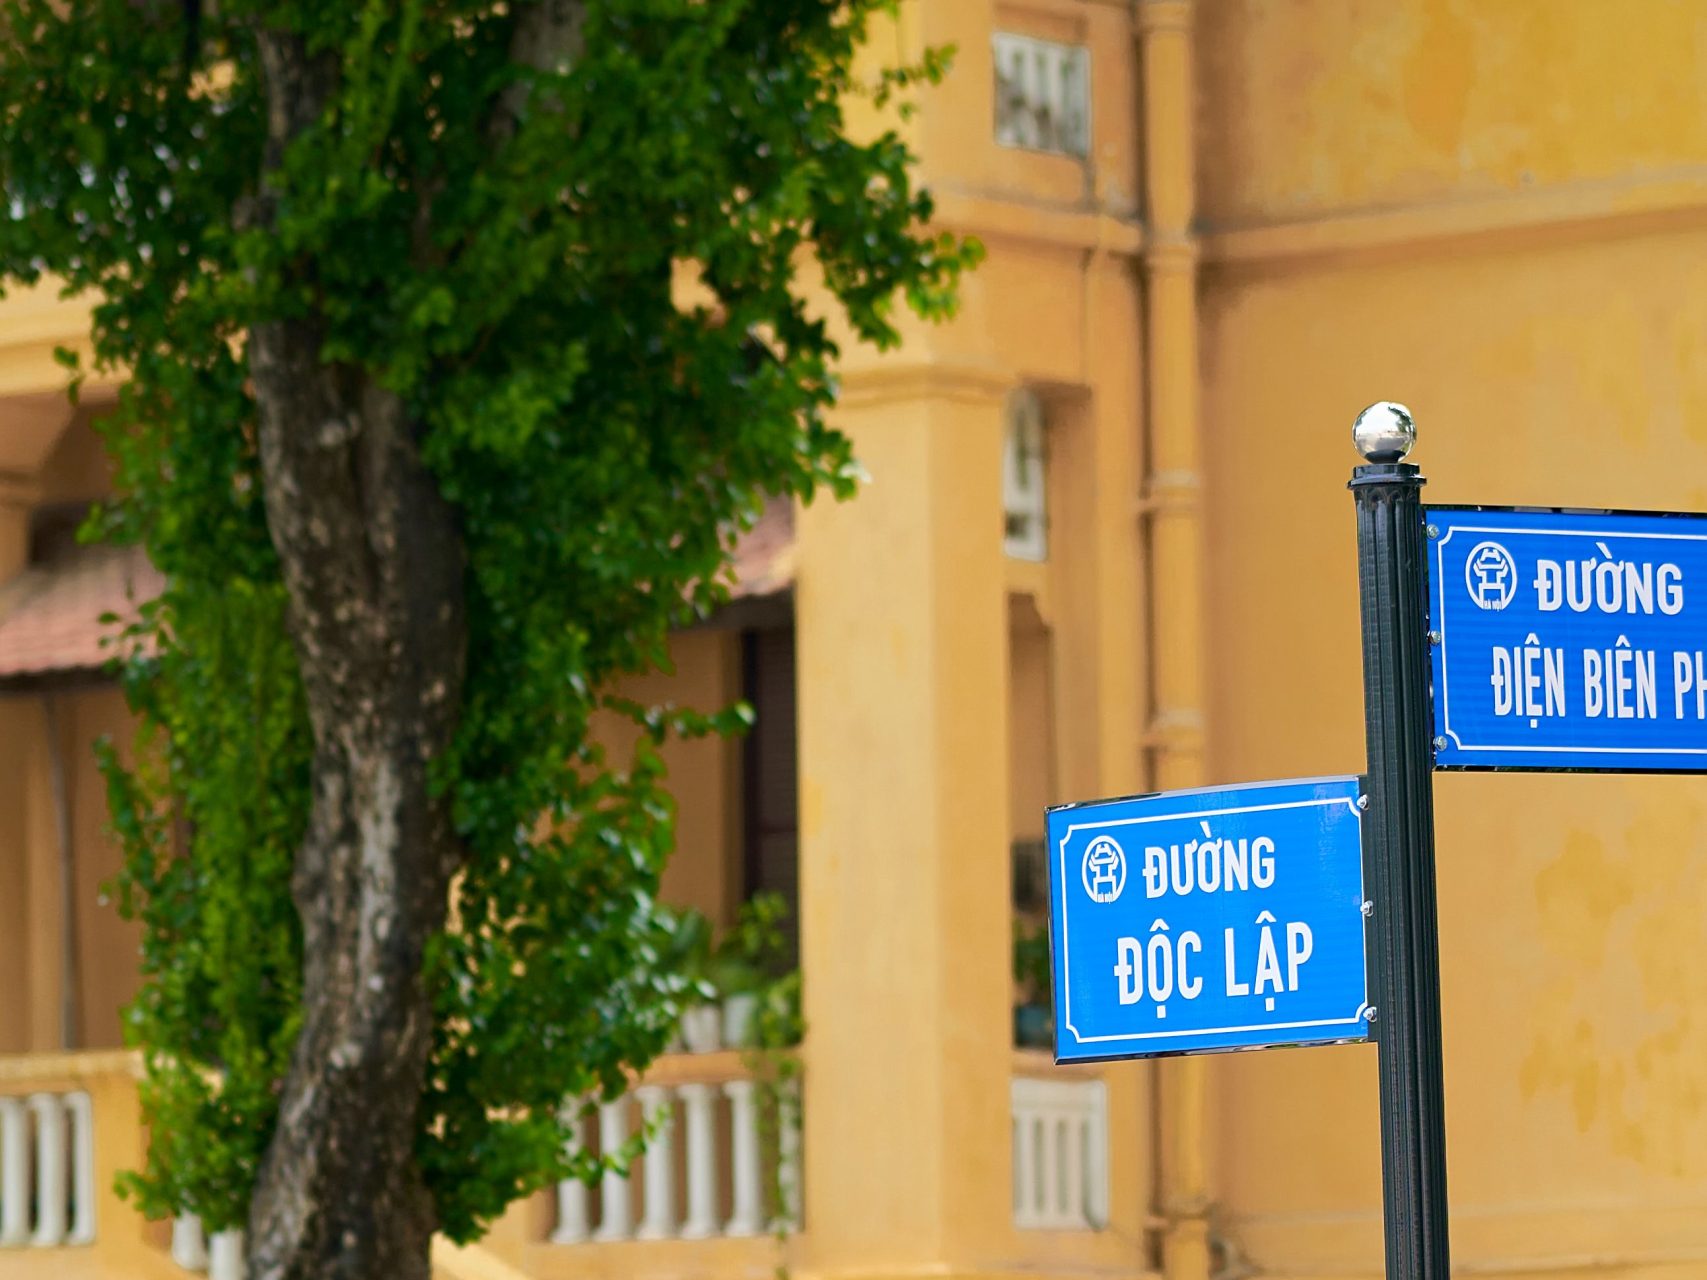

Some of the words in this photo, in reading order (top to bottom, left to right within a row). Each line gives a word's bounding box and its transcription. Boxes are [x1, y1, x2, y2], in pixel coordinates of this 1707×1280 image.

[1533, 541, 1684, 615] ĐƯỜNG
[1491, 632, 1566, 728] ĐIỆN
[1583, 634, 1657, 719] BIÊN
[1142, 821, 1275, 899] ĐƯỜNG
[1114, 918, 1203, 1018] ĐỘC
[1224, 910, 1313, 1011] LẬP
